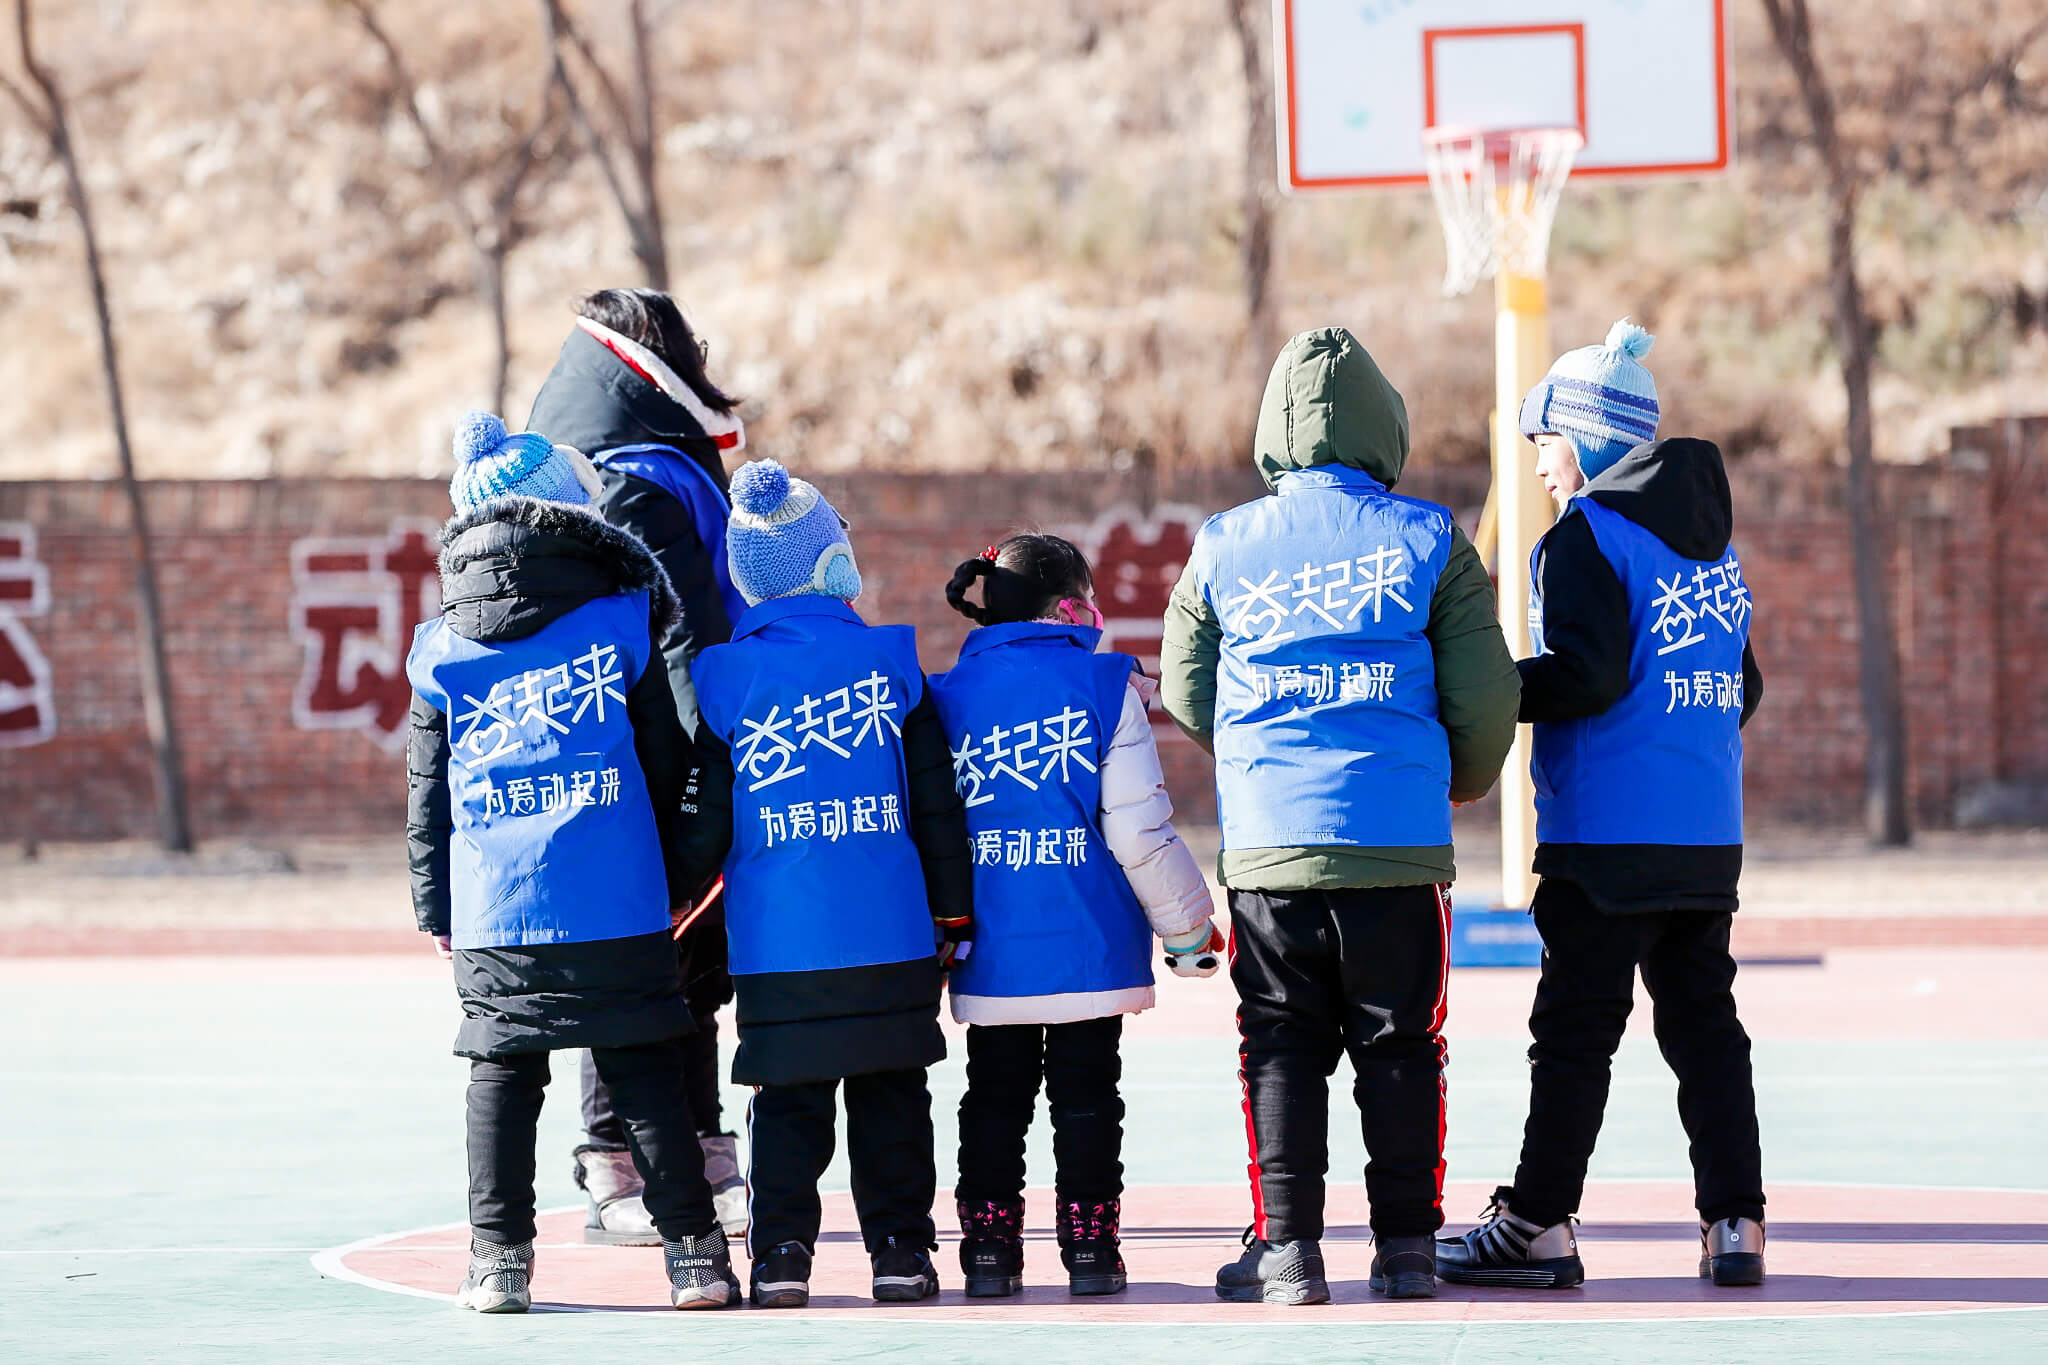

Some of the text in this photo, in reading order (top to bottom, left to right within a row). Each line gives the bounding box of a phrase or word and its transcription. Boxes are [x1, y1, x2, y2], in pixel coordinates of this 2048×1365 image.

[1248, 661, 1396, 705] 为爱动起来
[480, 767, 621, 823] 为爱动起来
[759, 793, 901, 848] 为爱动起来
[489, 1261, 527, 1271] FASHION
[673, 1258, 713, 1268] FASHION
